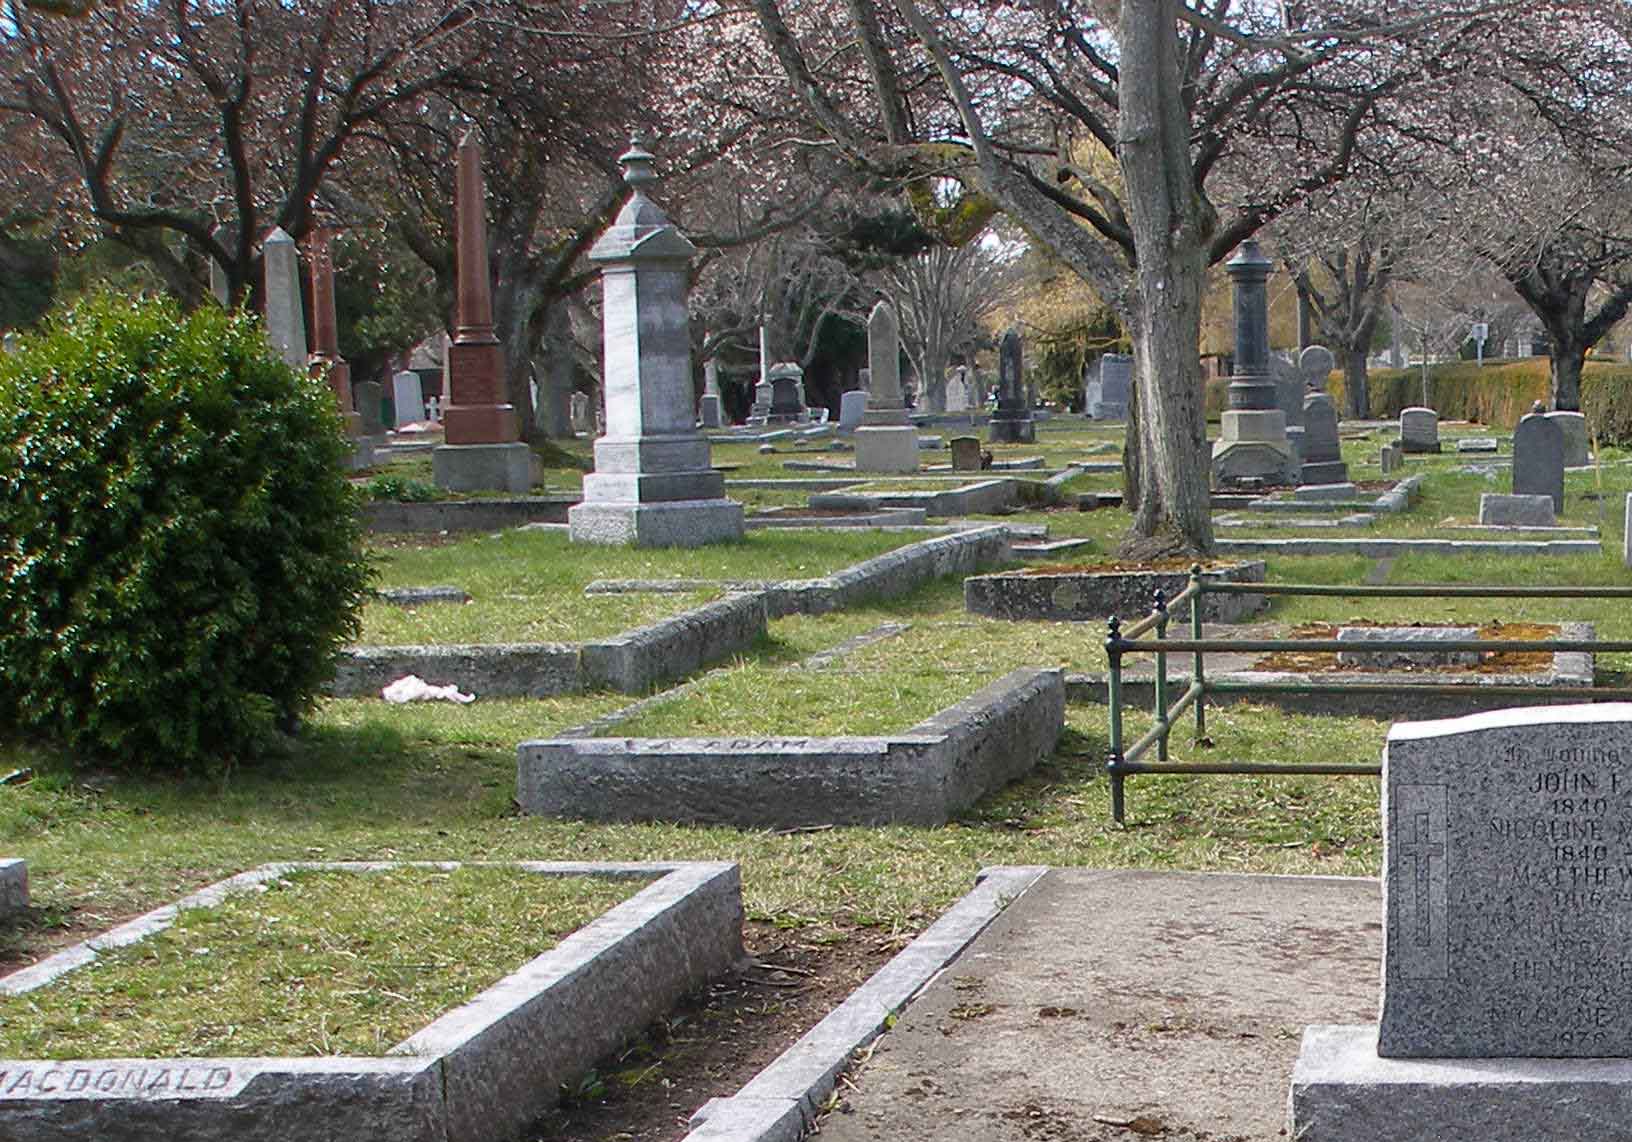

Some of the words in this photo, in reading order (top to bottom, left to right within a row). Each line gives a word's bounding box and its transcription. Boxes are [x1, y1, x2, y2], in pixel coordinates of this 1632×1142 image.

[1528, 772, 1598, 794] JOHN
[1553, 798, 1608, 816] 1840
[1554, 845, 1608, 863] 1840
